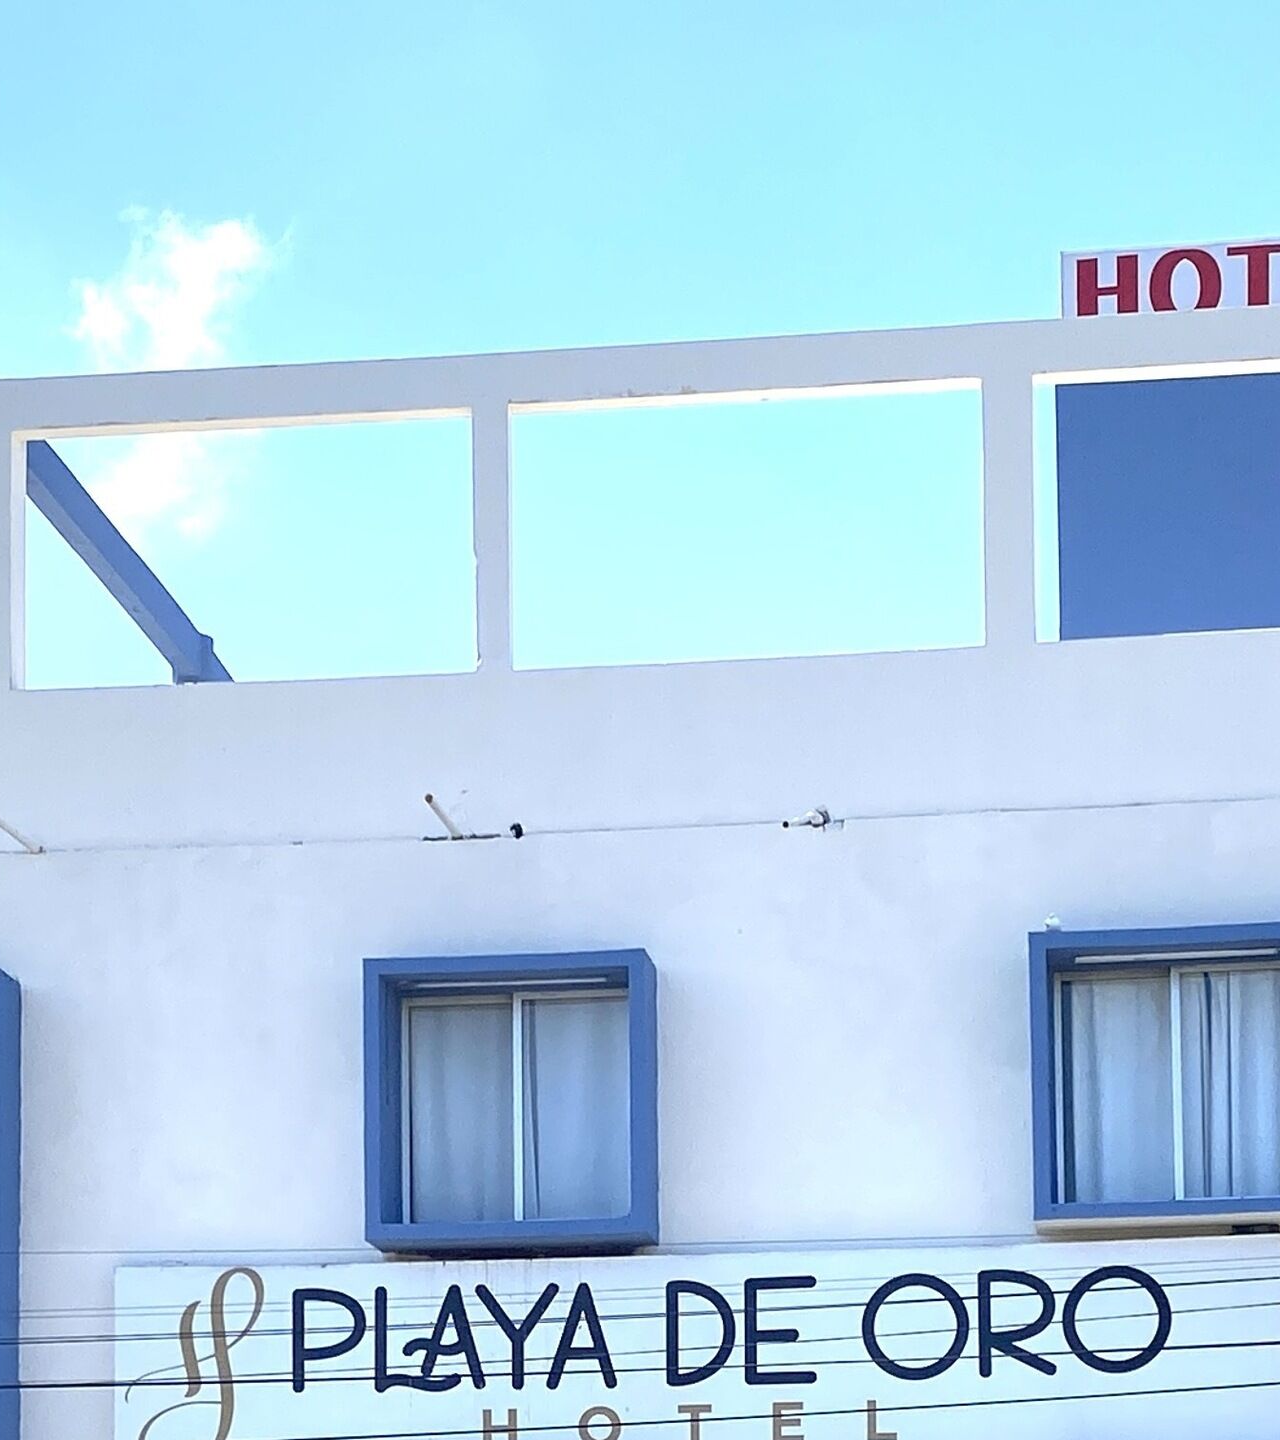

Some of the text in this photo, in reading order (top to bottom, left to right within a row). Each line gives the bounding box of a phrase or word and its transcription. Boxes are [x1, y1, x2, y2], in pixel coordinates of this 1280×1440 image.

[291, 1280, 618, 1393] PLAYA
[665, 1274, 818, 1387] DE
[860, 1264, 1173, 1381] ORO
